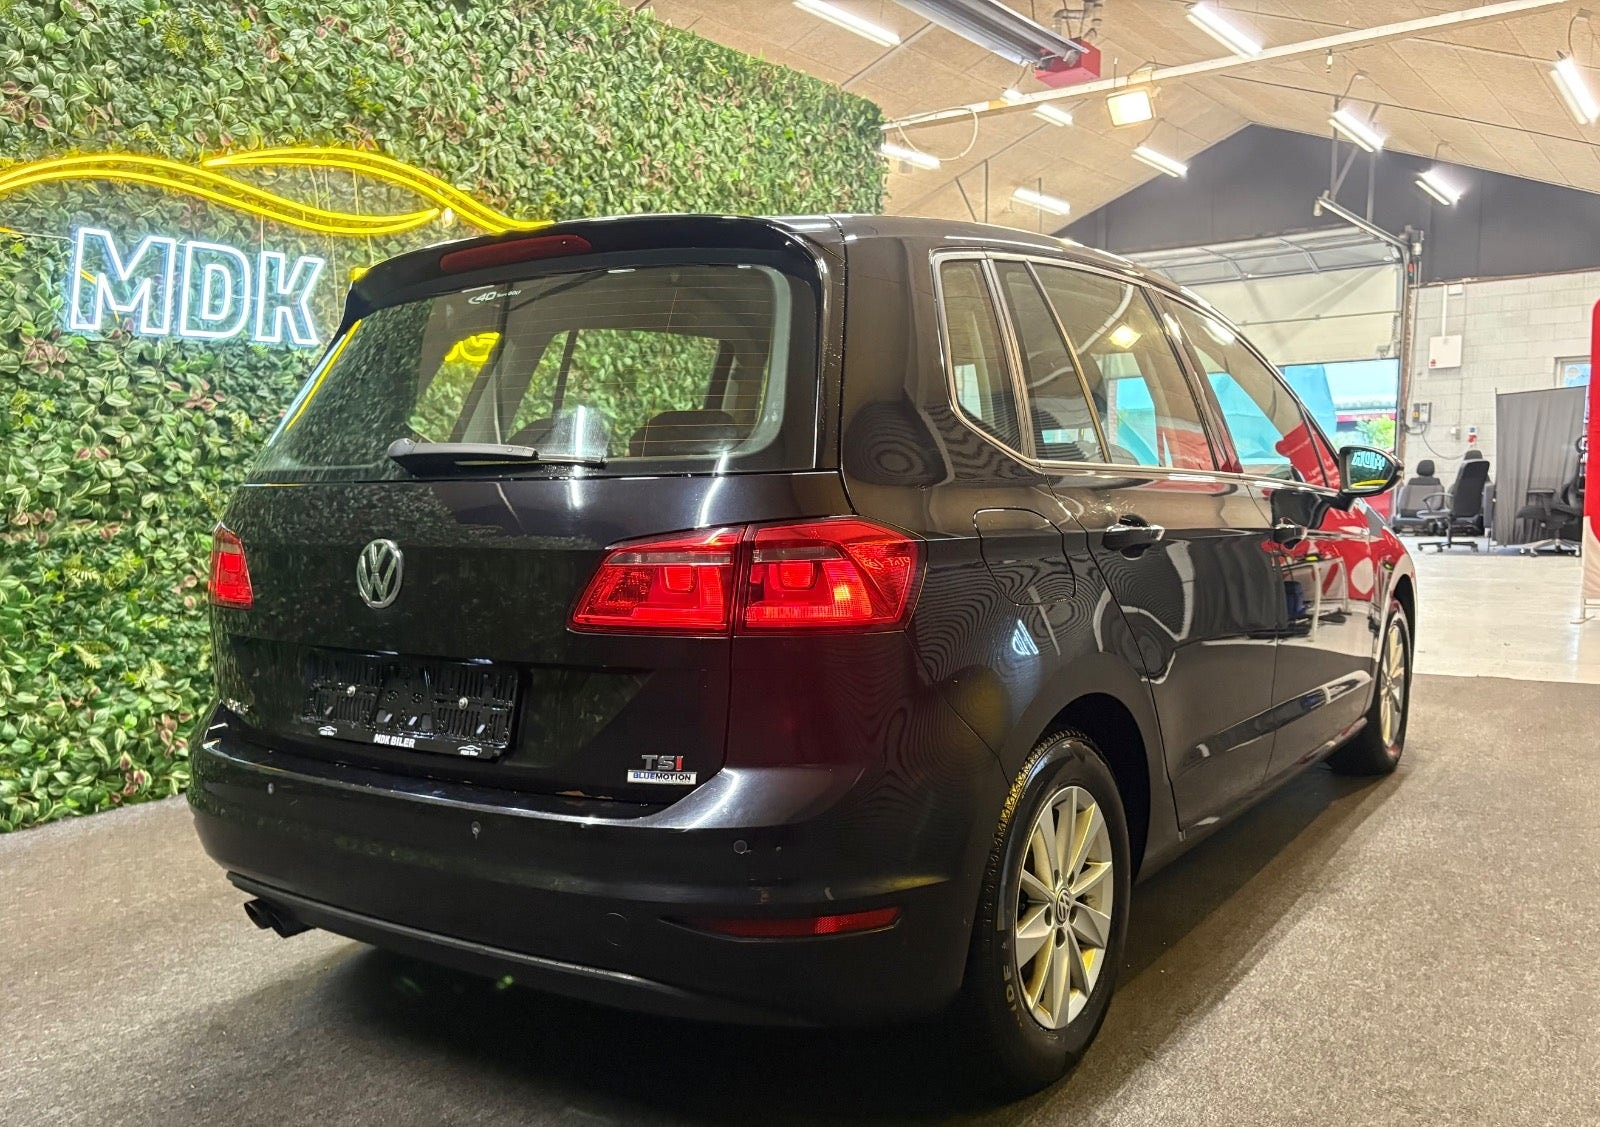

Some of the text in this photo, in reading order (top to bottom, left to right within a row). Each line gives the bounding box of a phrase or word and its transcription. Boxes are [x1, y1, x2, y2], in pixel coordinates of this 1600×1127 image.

[69, 227, 325, 345] MDK
[390, 736, 416, 748] BILER
[641, 754, 684, 771] TSI
[633, 772, 691, 780] BLUEMOTION
